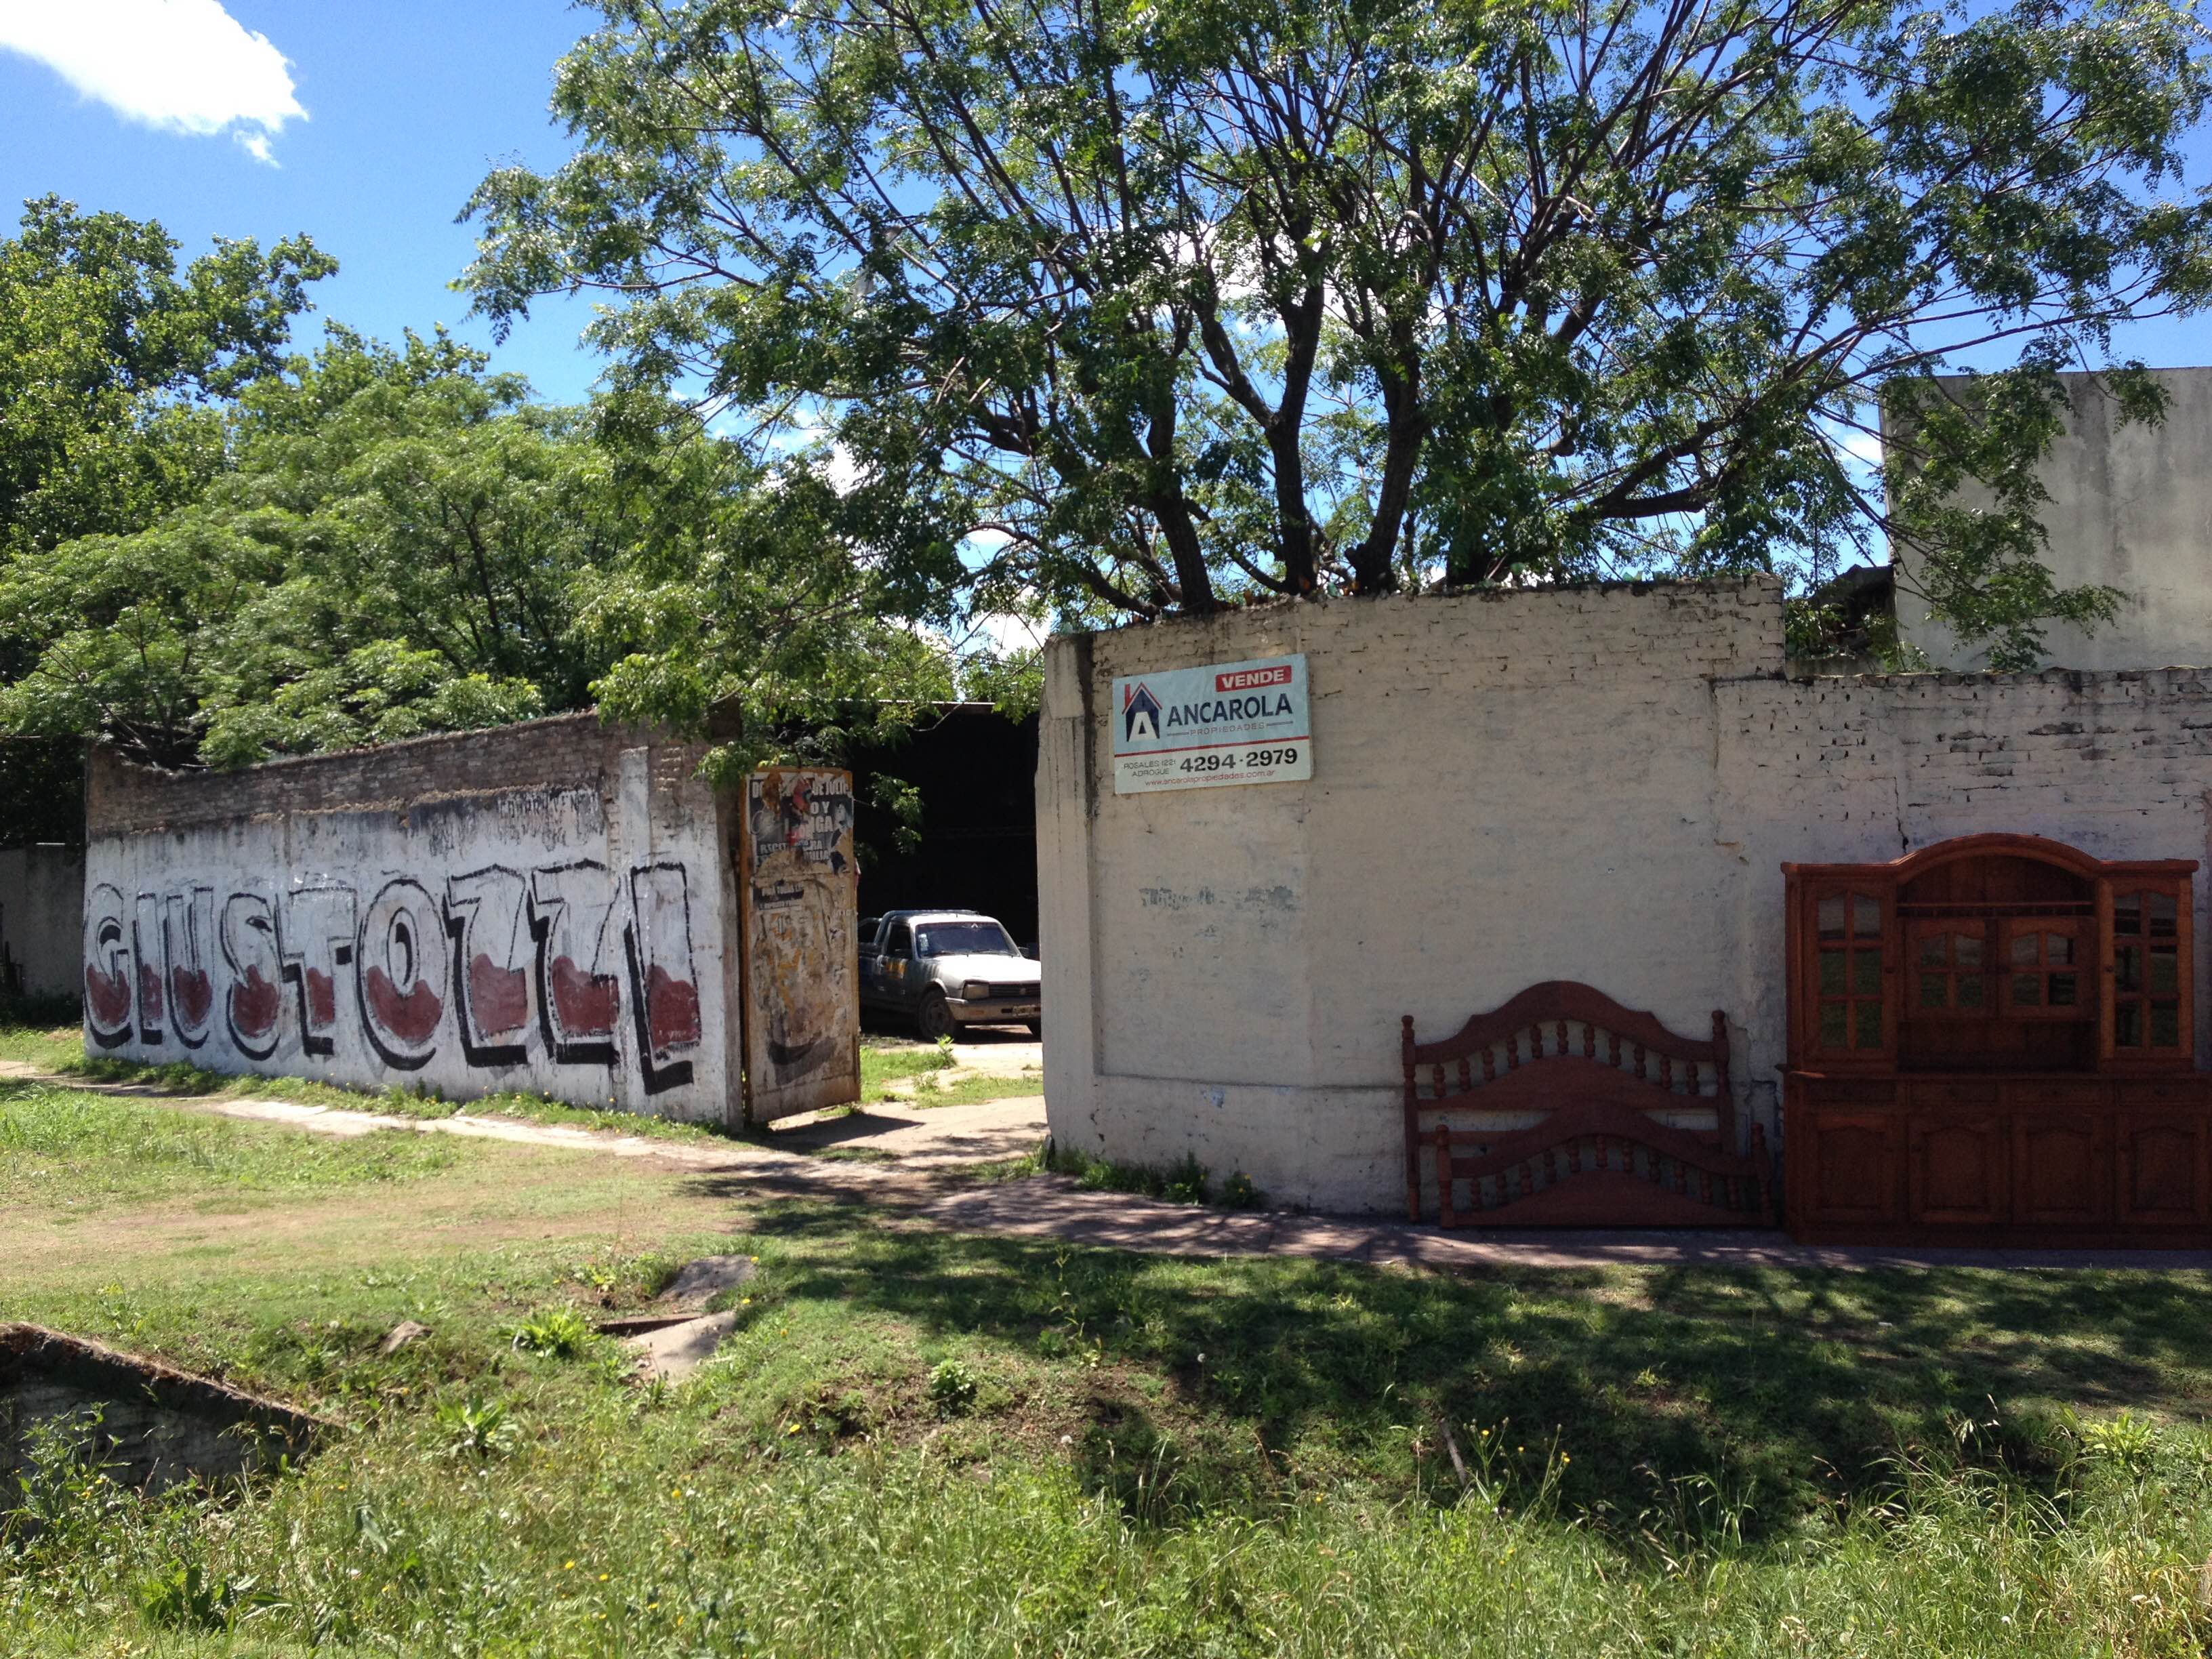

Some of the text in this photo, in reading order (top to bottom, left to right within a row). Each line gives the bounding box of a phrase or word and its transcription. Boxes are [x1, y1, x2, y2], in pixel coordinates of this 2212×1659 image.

[1221, 669, 1285, 689] VENDE
[1166, 693, 1293, 728] ANCAROLA
[1190, 722, 1266, 737] PROPIEDADES
[1124, 760, 1160, 770] ROSALES
